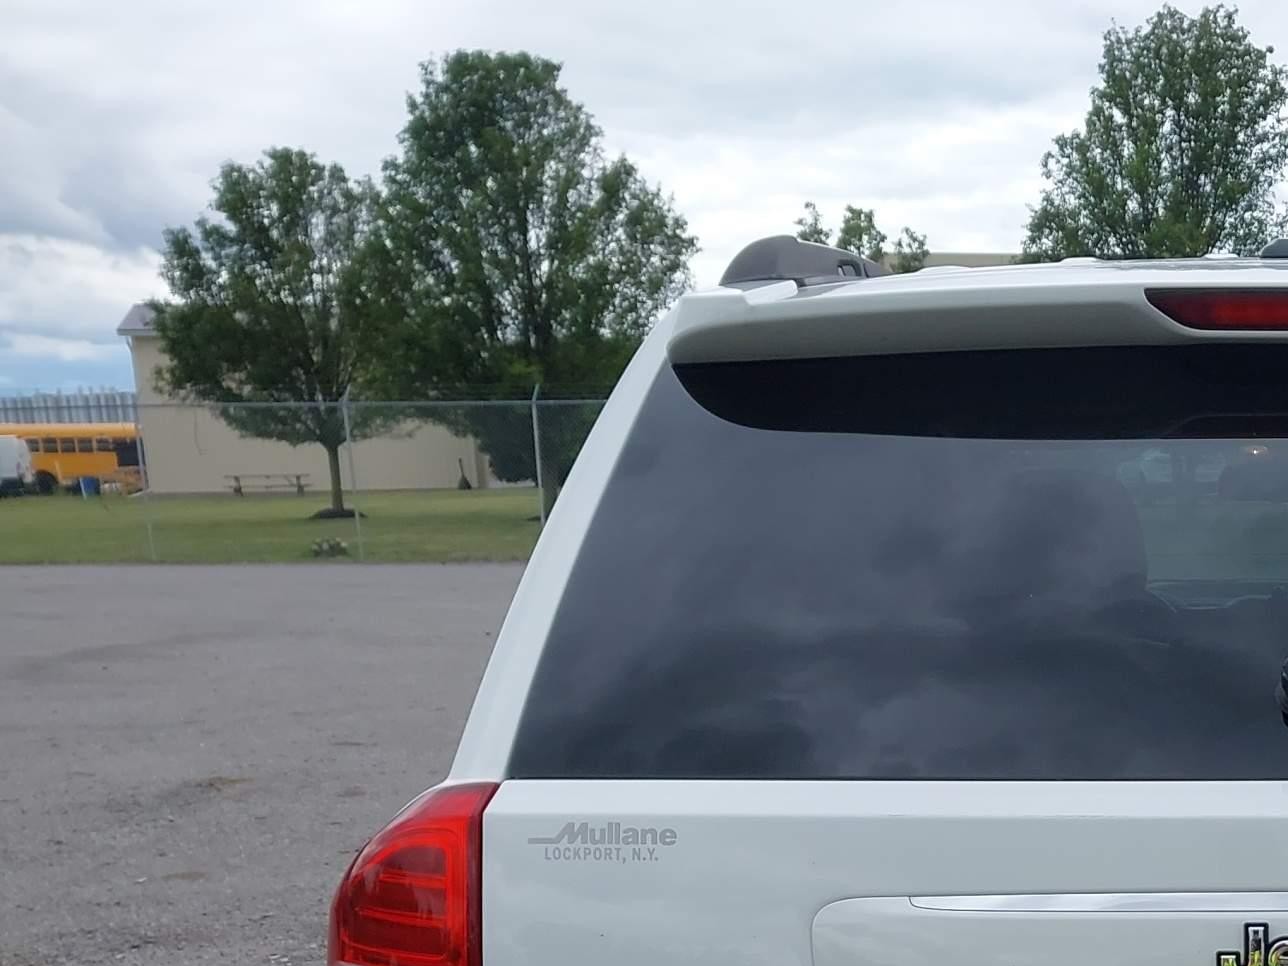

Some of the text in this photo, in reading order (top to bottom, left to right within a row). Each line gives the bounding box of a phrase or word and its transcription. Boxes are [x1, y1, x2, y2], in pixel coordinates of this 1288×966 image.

[528, 822, 677, 846] Mullane
[544, 847, 659, 863] LOCKPORT, N.Y.
